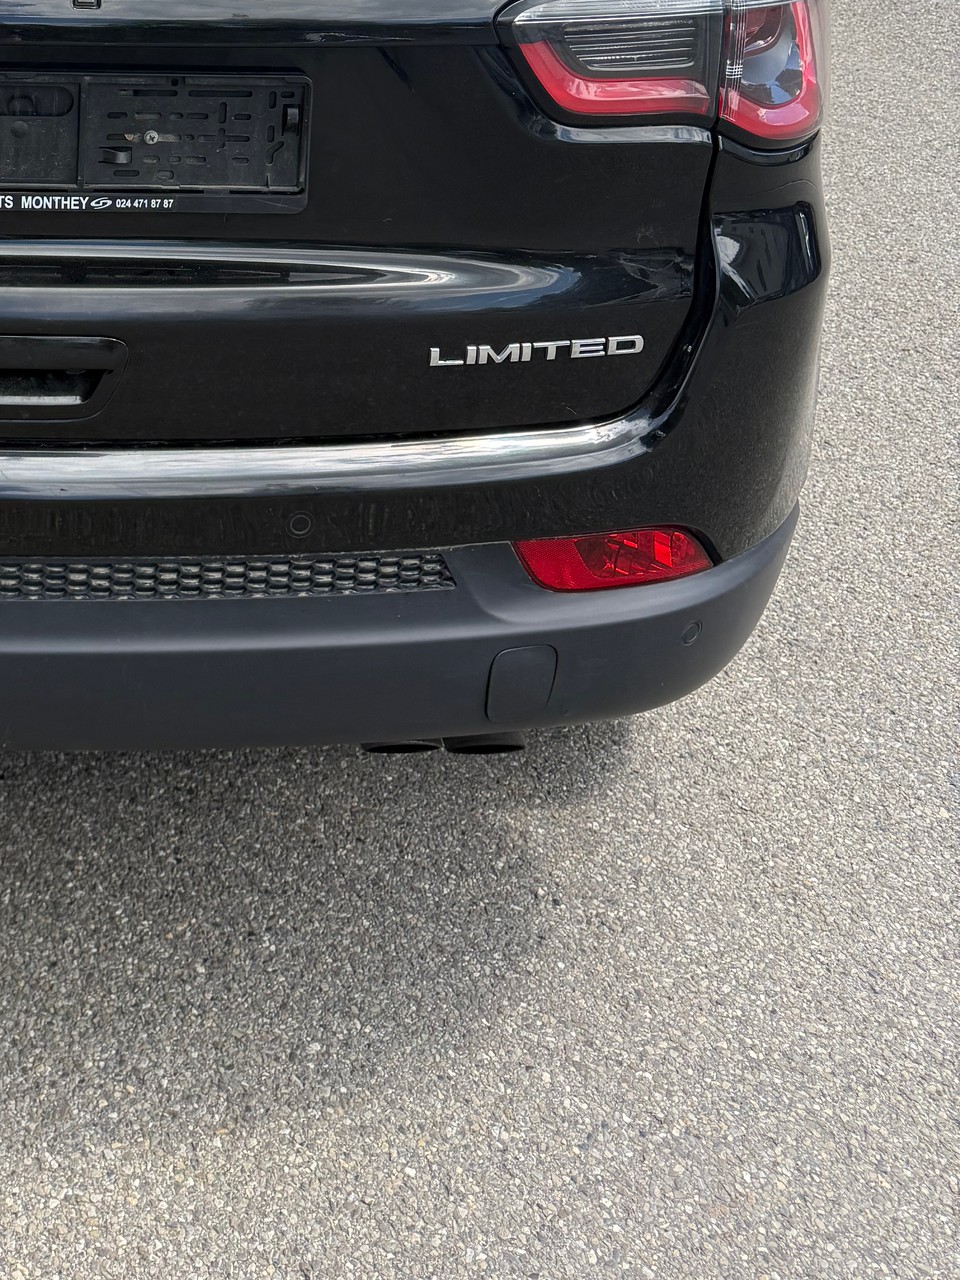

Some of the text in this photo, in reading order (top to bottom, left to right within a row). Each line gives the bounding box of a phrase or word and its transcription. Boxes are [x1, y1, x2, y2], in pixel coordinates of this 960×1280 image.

[21, 195, 90, 210] MONTHEY
[115, 198, 132, 208] 024
[133, 198, 148, 209] 471
[150, 198, 161, 209] 87
[163, 198, 174, 209] 87
[429, 334, 645, 367] LIMITED
